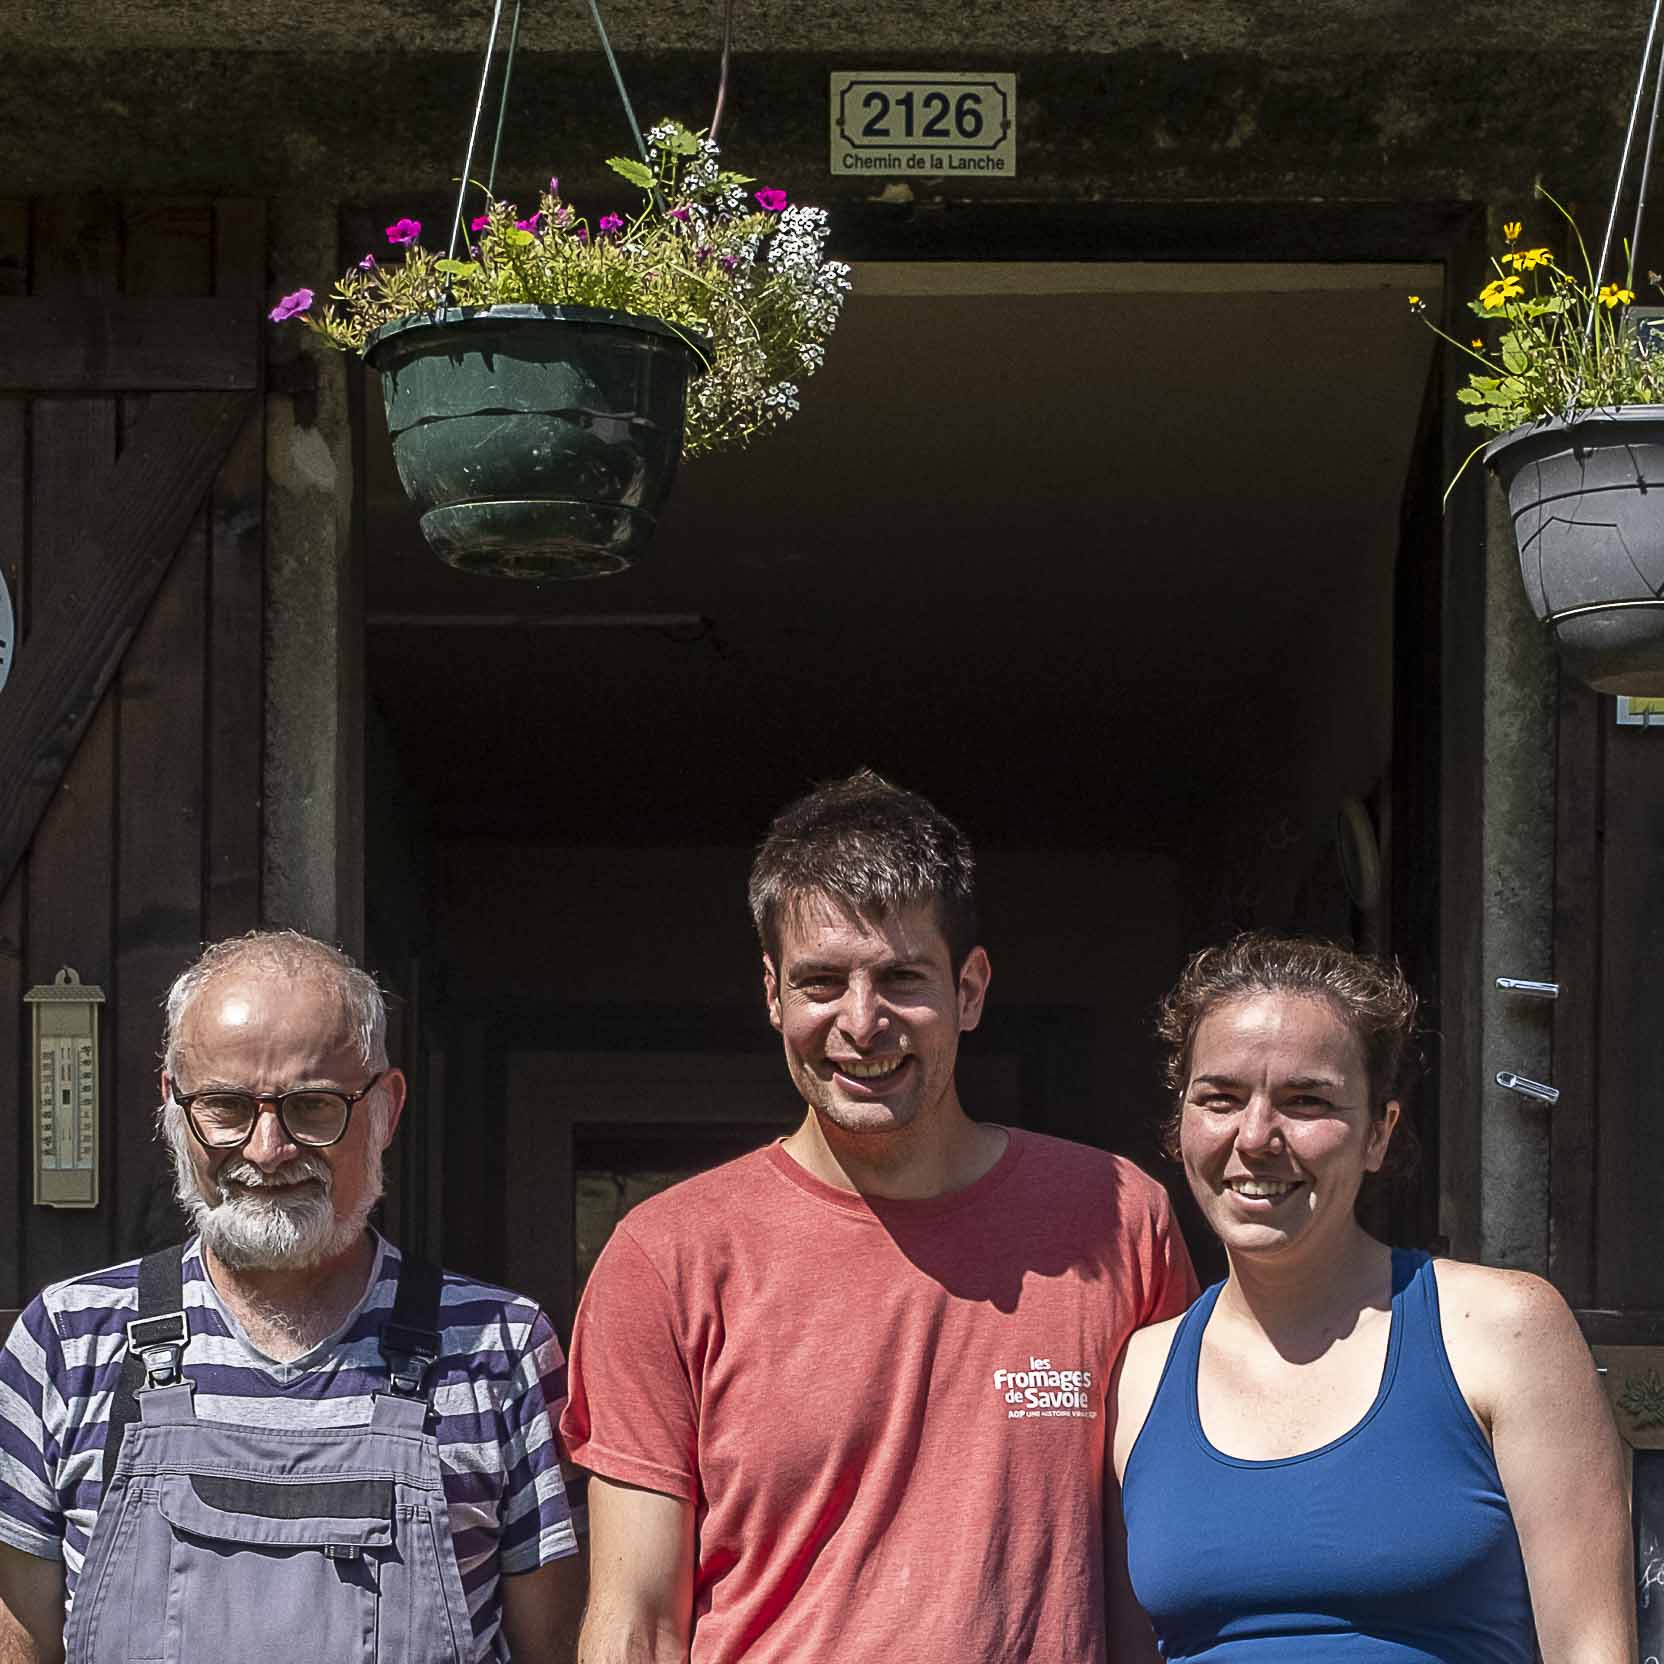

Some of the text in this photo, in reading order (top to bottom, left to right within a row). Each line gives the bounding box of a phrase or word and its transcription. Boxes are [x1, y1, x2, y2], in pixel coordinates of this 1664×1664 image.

[862, 91, 983, 139] 2126
[842, 153, 1005, 170] Chemin de la Lanche
[1029, 1356, 1051, 1370] les
[993, 1369, 1092, 1391] Fromages
[1005, 1387, 1088, 1409] de Savoie
